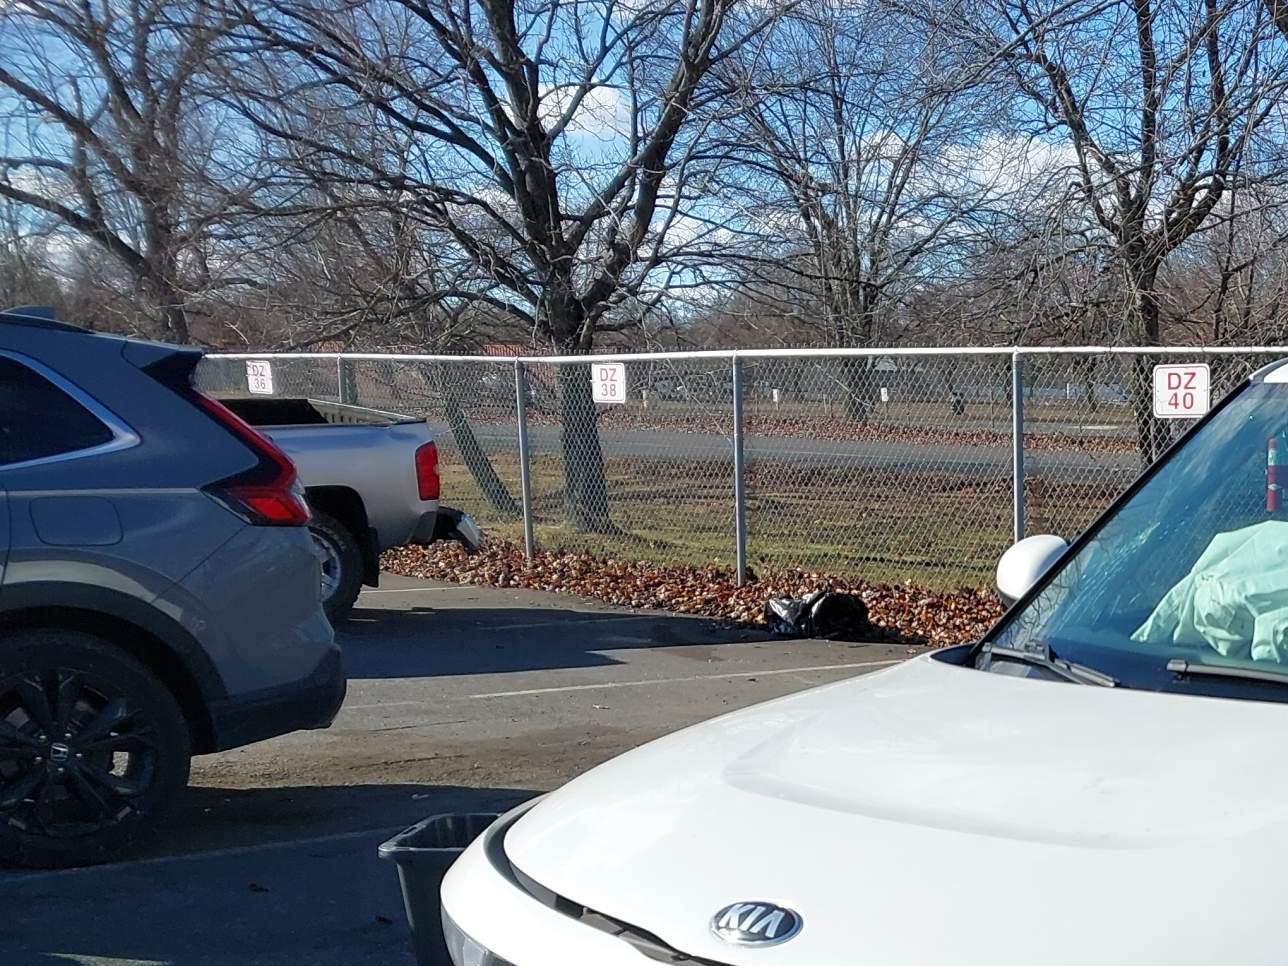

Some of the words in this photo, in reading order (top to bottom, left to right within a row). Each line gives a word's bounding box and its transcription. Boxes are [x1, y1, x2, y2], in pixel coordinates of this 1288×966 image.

[252, 365, 265, 377] DZ
[600, 367, 617, 381] DZ
[1167, 372, 1197, 390] DZ
[601, 383, 617, 397] 38
[1168, 392, 1194, 410] 40
[717, 902, 786, 938] KIA
